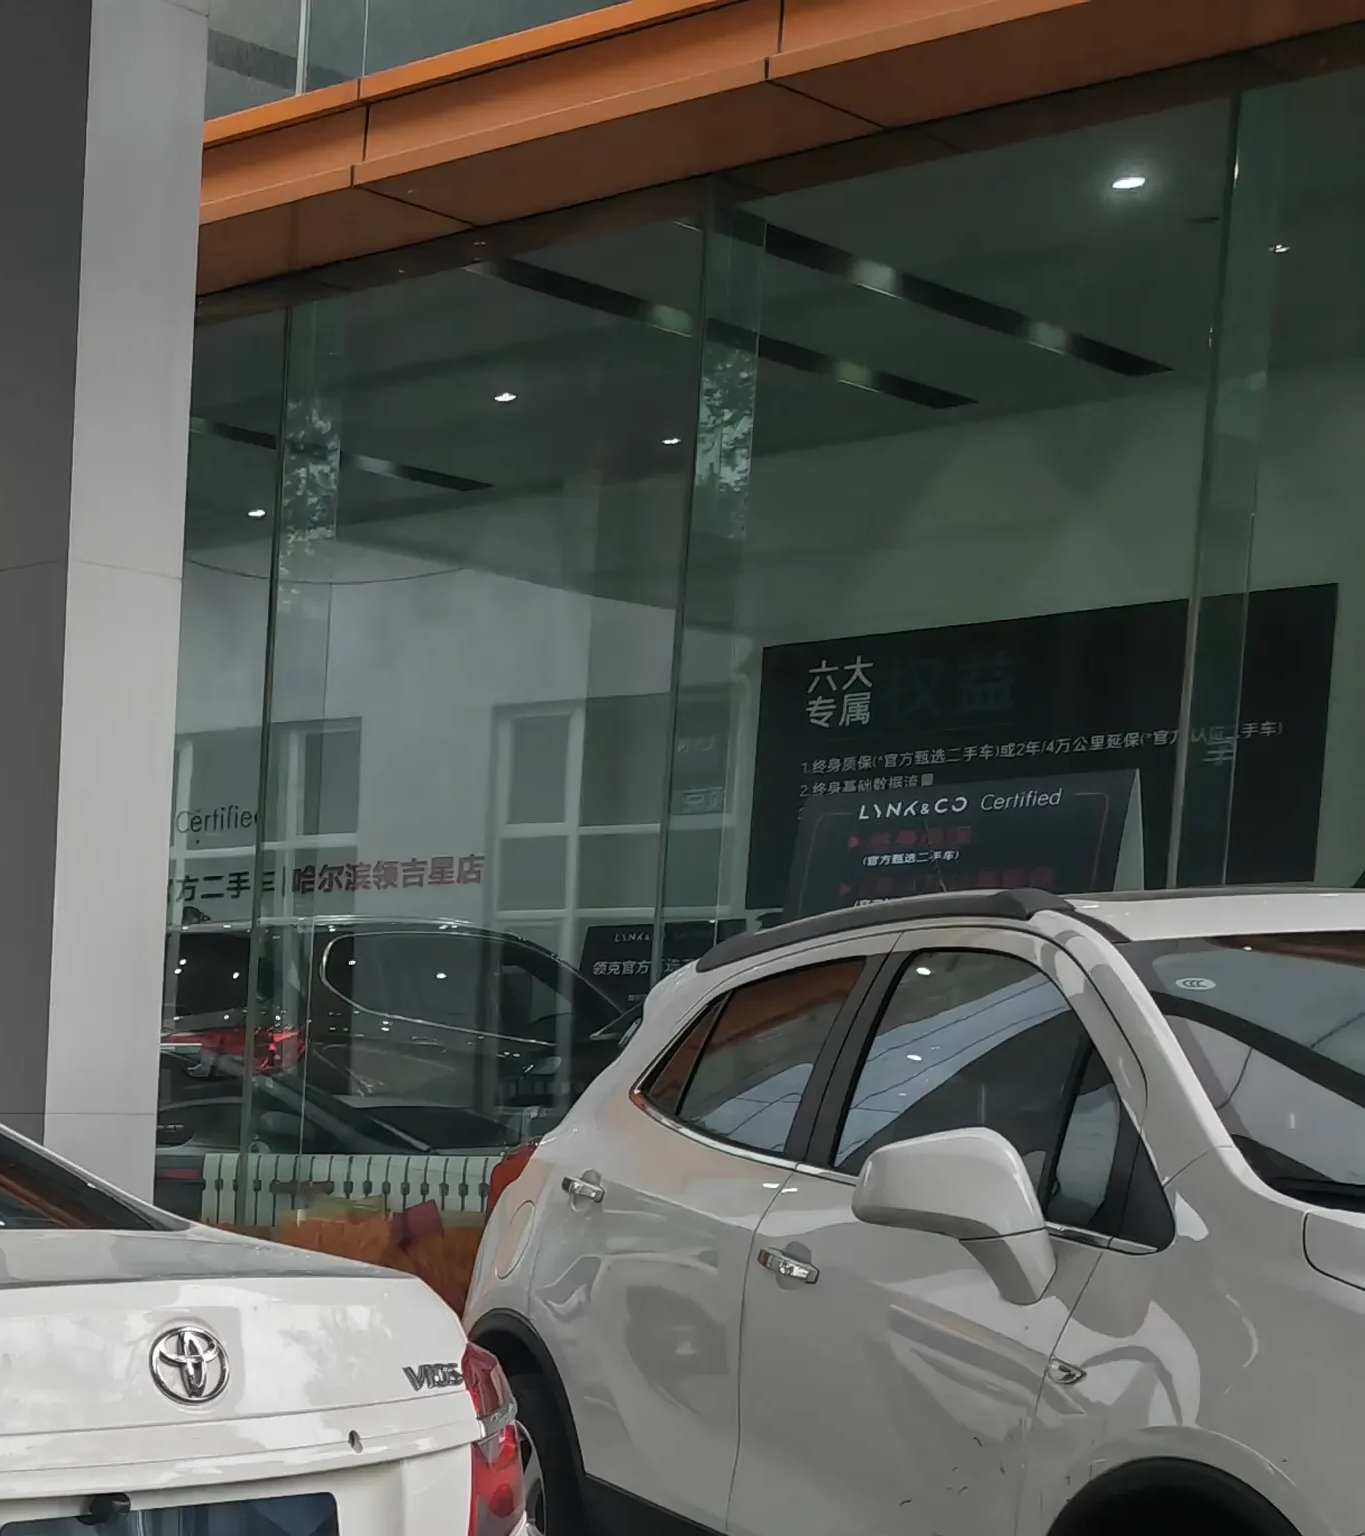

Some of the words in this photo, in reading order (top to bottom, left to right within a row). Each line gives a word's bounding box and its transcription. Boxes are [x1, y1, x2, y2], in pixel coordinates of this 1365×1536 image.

[807, 655, 873, 693] 六大
[805, 692, 871, 728] 专属
[980, 788, 1063, 811] Certified
[292, 854, 485, 893] 哈尔滨领吉星店
